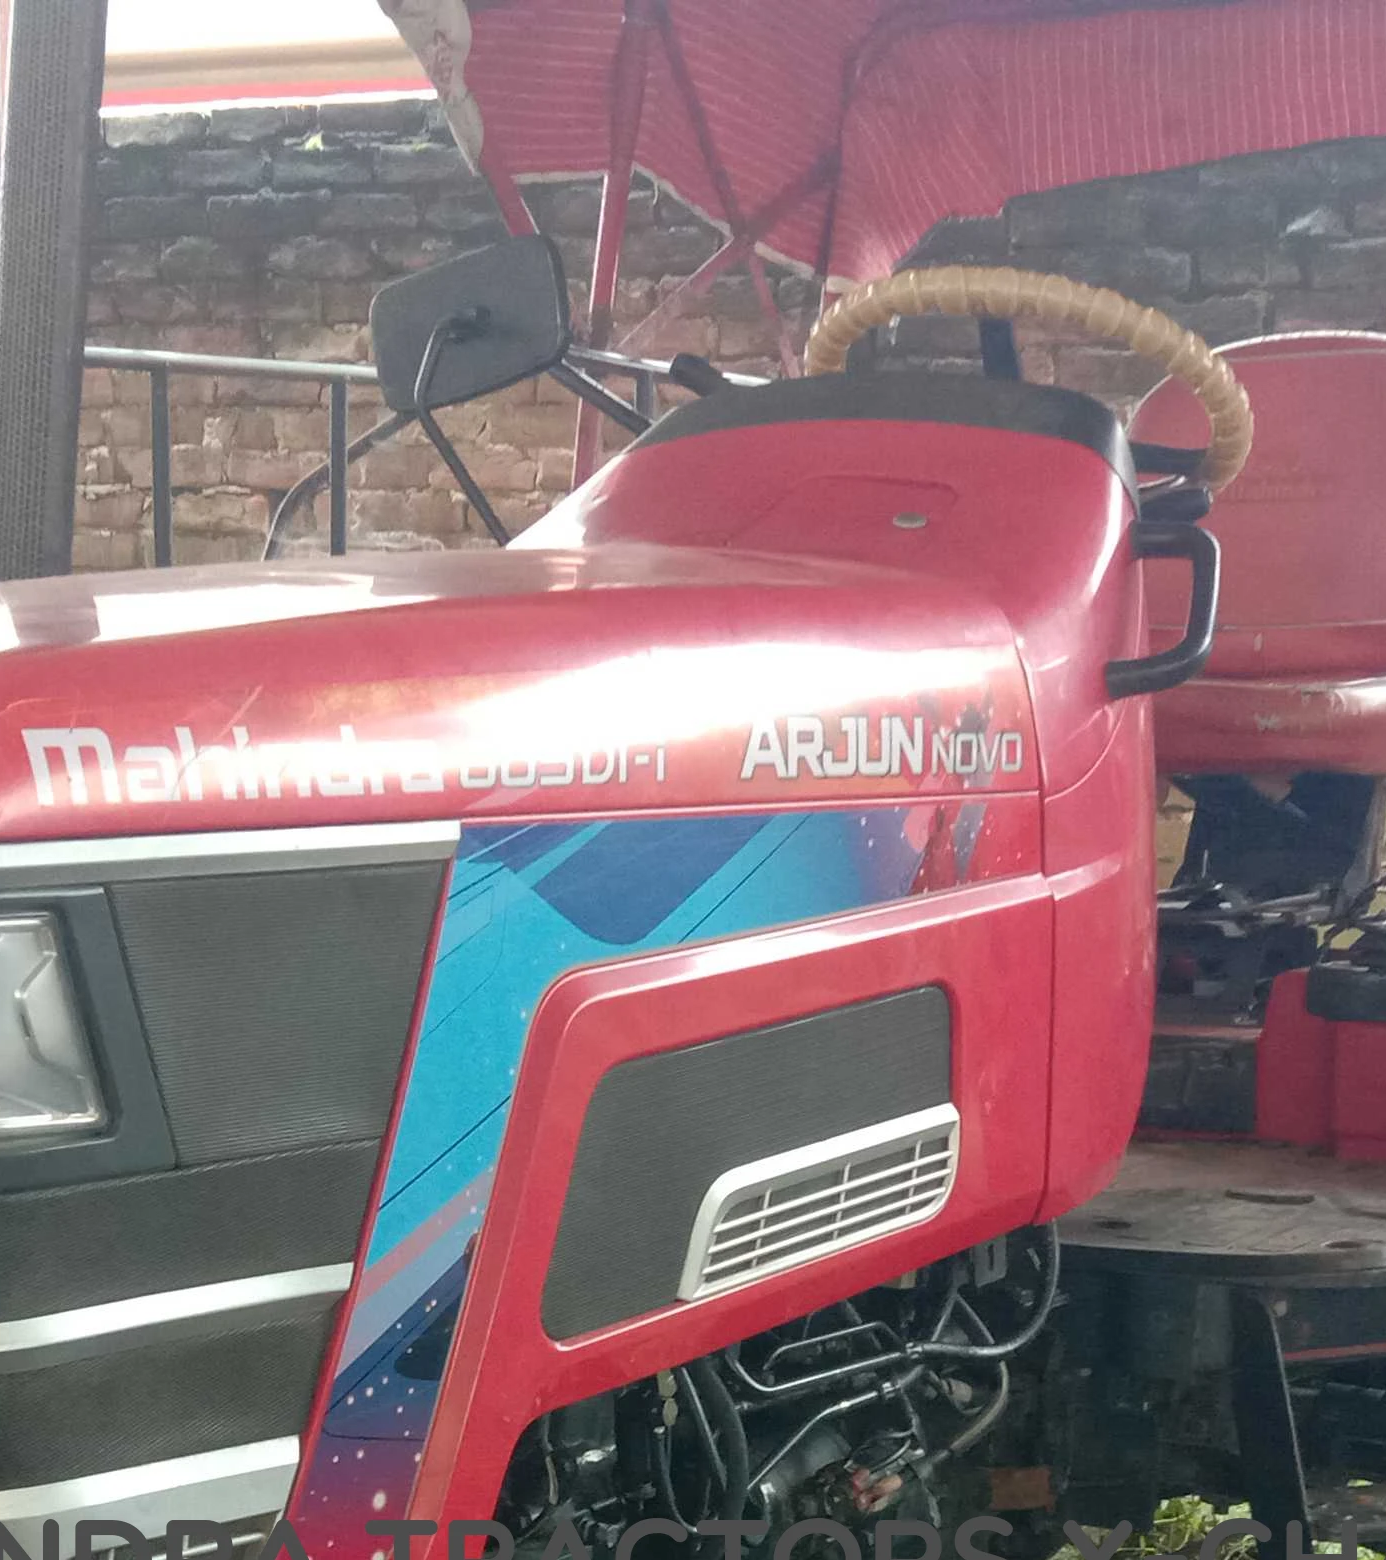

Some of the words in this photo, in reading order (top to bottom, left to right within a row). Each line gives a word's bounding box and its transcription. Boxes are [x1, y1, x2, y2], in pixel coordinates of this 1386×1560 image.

[20, 723, 445, 806] Mahindra
[739, 714, 925, 780] ARJUN
[931, 730, 1022, 776] NOVO
